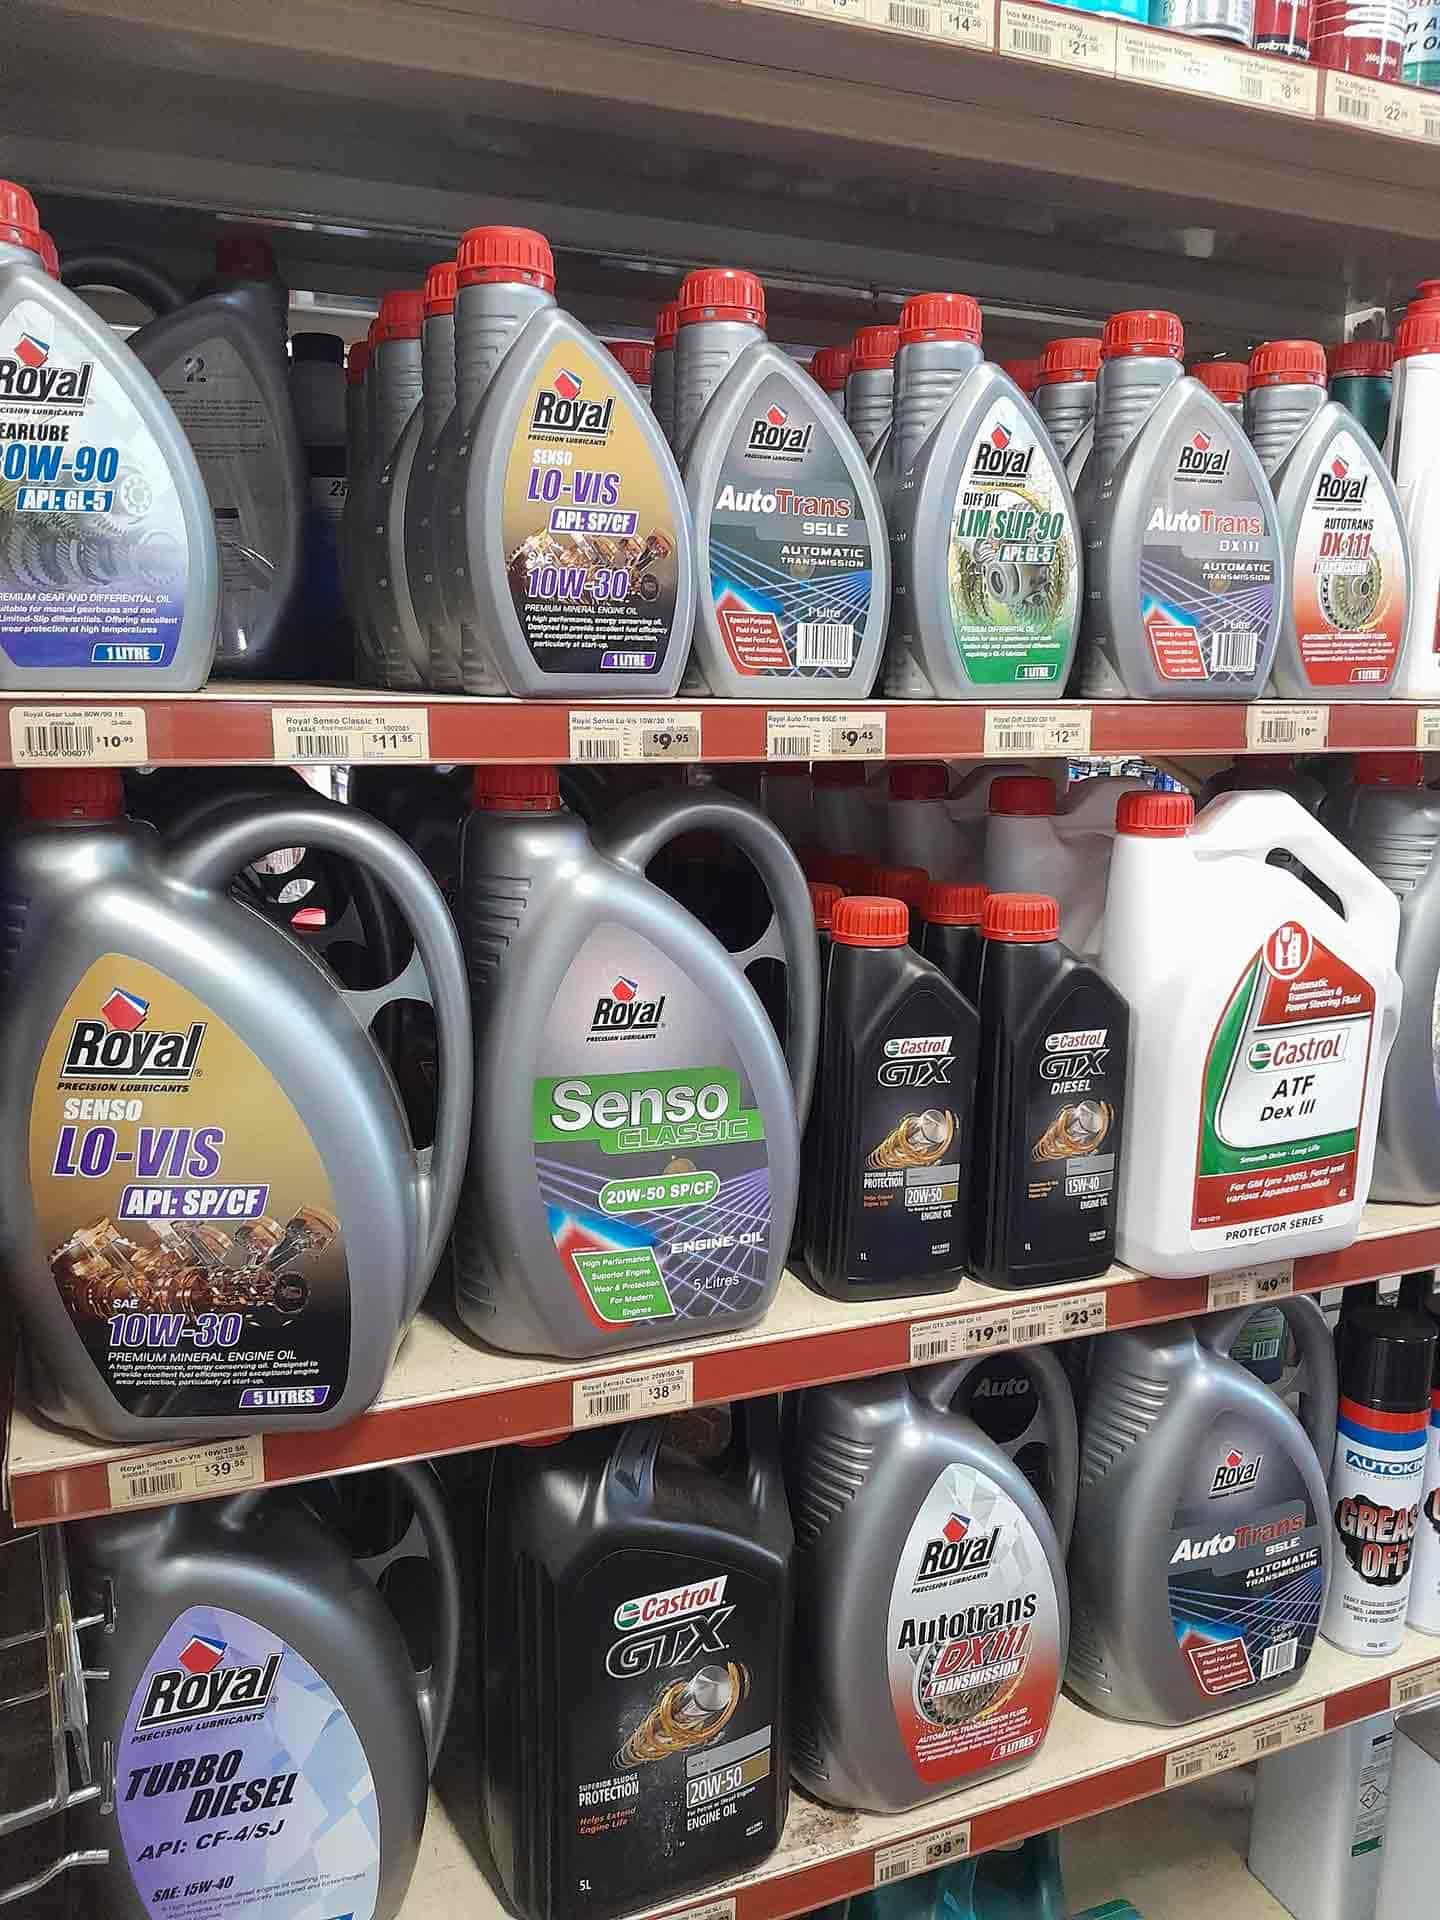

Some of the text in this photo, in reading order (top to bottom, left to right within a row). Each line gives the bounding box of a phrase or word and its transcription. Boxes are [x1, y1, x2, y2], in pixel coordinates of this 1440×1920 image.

[0, 360, 91, 403] Royal
[32, 408, 84, 417] LUBRICANTS
[534, 391, 615, 434] Royal
[528, 434, 606, 447] PRECISION LUBRICANTS
[750, 421, 812, 451] Royal
[533, 450, 573, 465] SENSO
[974, 443, 1034, 477] Royal
[1178, 446, 1230, 474] Royal
[528, 467, 620, 505] LO-VIS
[1316, 473, 1367, 500] Royal
[24, 490, 106, 512] API: GL-5
[715, 484, 850, 519] AutoTrans
[963, 492, 999, 508] DIFF OIL
[555, 511, 632, 533] API: SP/CF
[802, 521, 849, 537] 95LE
[957, 509, 1065, 541] LIM SLIP 90
[1147, 507, 1261, 536] AutoTrans
[1324, 517, 1375, 531] AUTOTRANS
[781, 545, 865, 559] AUTOMATIC
[781, 556, 864, 568] TRANSMISSION
[1202, 562, 1271, 573] AUTOMATIC
[1202, 572, 1271, 582] TRANSMISSION
[527, 567, 630, 600] 10W-30
[525, 604, 561, 614] PREMIUM
[116, 647, 151, 660] LITRE
[24, 711, 44, 720] Royal
[286, 717, 311, 728] Royal
[313, 717, 340, 726] Senso
[342, 716, 373, 725] Classic
[372, 734, 414, 750] $11.95
[652, 733, 689, 750] $9.95
[592, 995, 665, 1030] Royal
[67, 1022, 205, 1077] Royal
[900, 1039, 946, 1055] Castrol
[1059, 1031, 1103, 1049] Castrol
[1272, 1032, 1341, 1067] Castrol
[878, 1056, 957, 1088] GTX
[1040, 1048, 1112, 1081] GTX
[57, 1082, 190, 1094] PRECISION LUBRICANTS
[1051, 1079, 1092, 1096] DIESEL
[1272, 1074, 1316, 1100] ATF
[64, 1098, 144, 1121] SENSO
[551, 1079, 729, 1132] Senso
[1260, 1104, 1294, 1122] Dex
[617, 1118, 749, 1151] CLASSIC
[53, 1125, 226, 1179] LO-VIS
[606, 1180, 714, 1204] 20W-50 SP/CF
[864, 1176, 904, 1189] PROTECTION
[1068, 1176, 1100, 1194] 15W-40
[127, 1188, 260, 1216] API: SP/CF
[908, 1188, 943, 1205] 20W-50
[1226, 1221, 1287, 1241] PROTECTOR
[1290, 1214, 1325, 1230] SERIES
[671, 1230, 765, 1255] ENGINE OIL
[625, 1267, 651, 1279] Engine
[705, 1274, 741, 1290] Litres
[113, 1299, 140, 1310] SAE
[108, 1312, 244, 1348] 10W-30
[108, 1351, 297, 1362] PREMIUM MINERAL ENGINE OIL
[254, 1388, 316, 1404] 5 LITRES
[972, 1377, 1029, 1399] Auto
[120, 1462, 145, 1474] Royal
[146, 1457, 174, 1469] Senso
[1213, 1455, 1263, 1488] Royal
[1169, 1513, 1306, 1564] AutoTrans
[1264, 1536, 1301, 1556] 95LE
[919, 1527, 1001, 1578] Royal
[1246, 1548, 1319, 1579] AUTOMATIC
[1360, 1542, 1409, 1579] OFF
[911, 1580, 948, 1595] PRECISION
[1245, 1560, 1318, 1588] TRANSMISSION
[641, 1581, 719, 1622] Castrol
[897, 1593, 1038, 1651] Autotrans
[606, 1604, 737, 1679] GTX
[141, 1654, 283, 1719] Royal
[930, 1657, 1020, 1695] TRANSMISSION
[130, 1712, 265, 1744] PRECISION LUBRICANTS
[124, 1749, 244, 1802] TURBO
[690, 1766, 743, 1804] 20W-50
[184, 1772, 298, 1824] DIESEL
[578, 1781, 640, 1808] PROTECTION
[687, 1802, 738, 1832] ENGINE OIL
[136, 1819, 285, 1862] API: CF-4/SJ
[151, 1886, 182, 1902] SAE:
[183, 1875, 234, 1898] 15W-40
[579, 1879, 592, 1891] 5L
